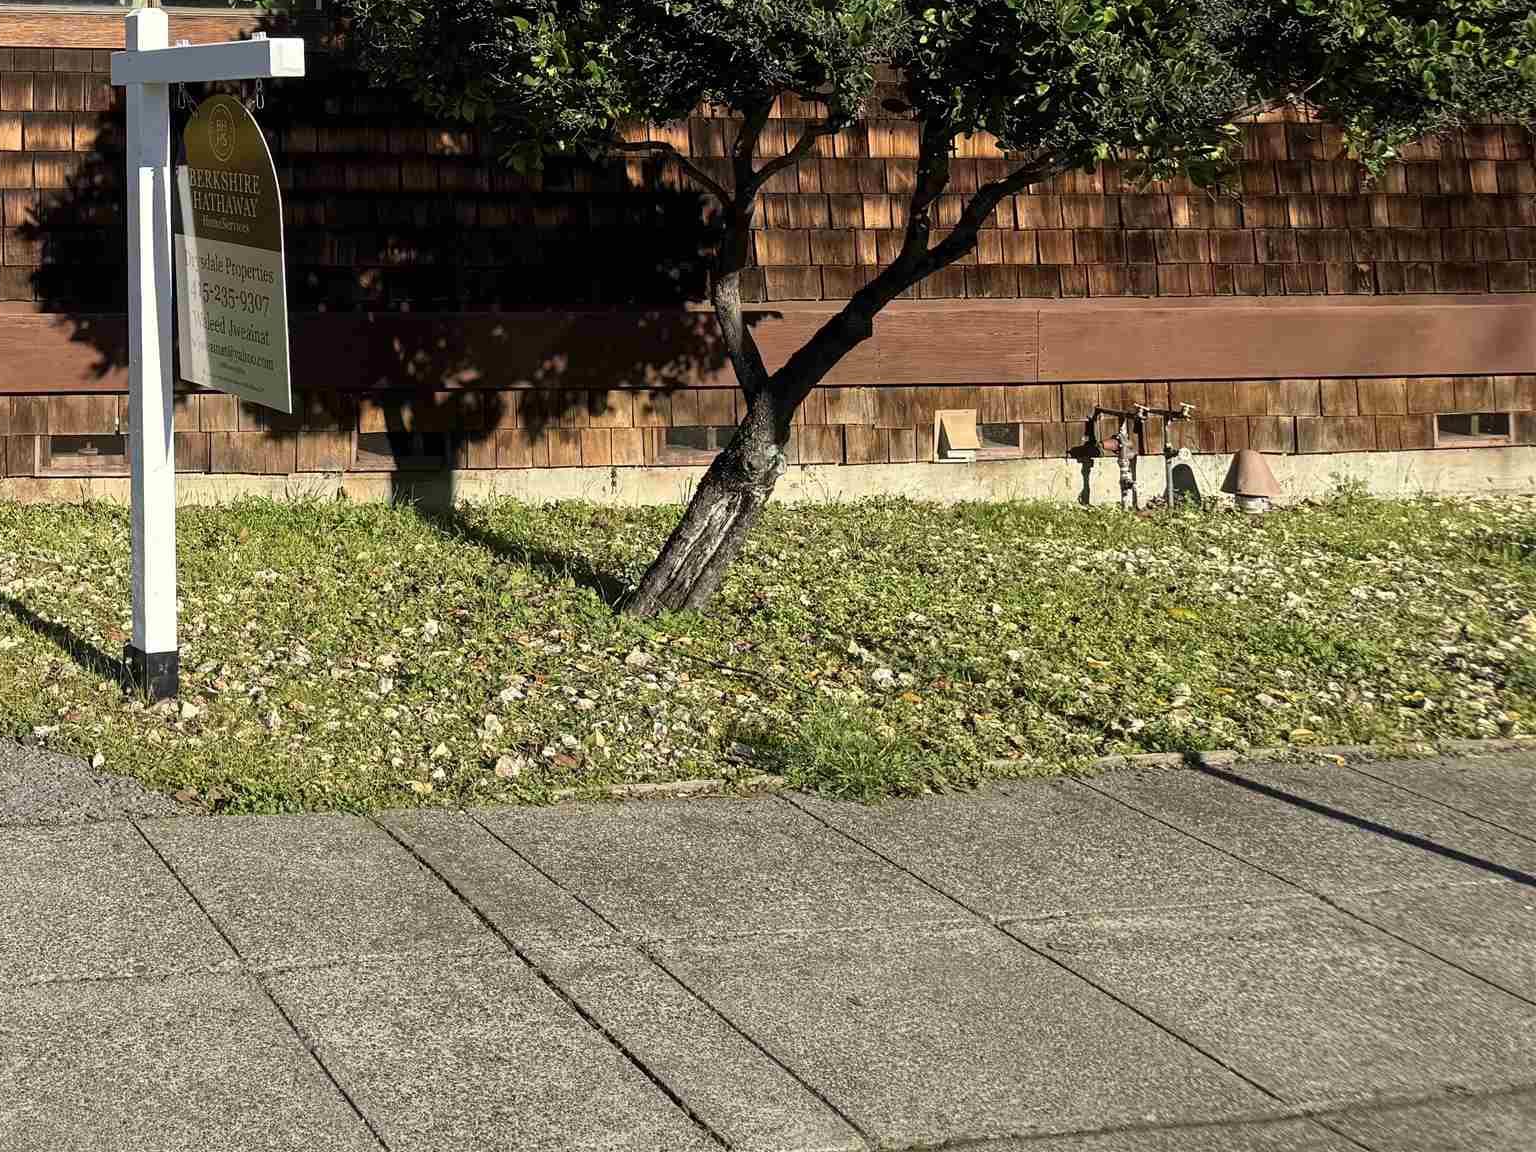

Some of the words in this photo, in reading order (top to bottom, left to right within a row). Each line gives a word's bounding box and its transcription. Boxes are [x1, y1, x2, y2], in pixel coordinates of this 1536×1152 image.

[190, 168, 261, 195] BERKSHIRE
[192, 191, 258, 218] HATHAWAY
[225, 256, 275, 284] Properties
